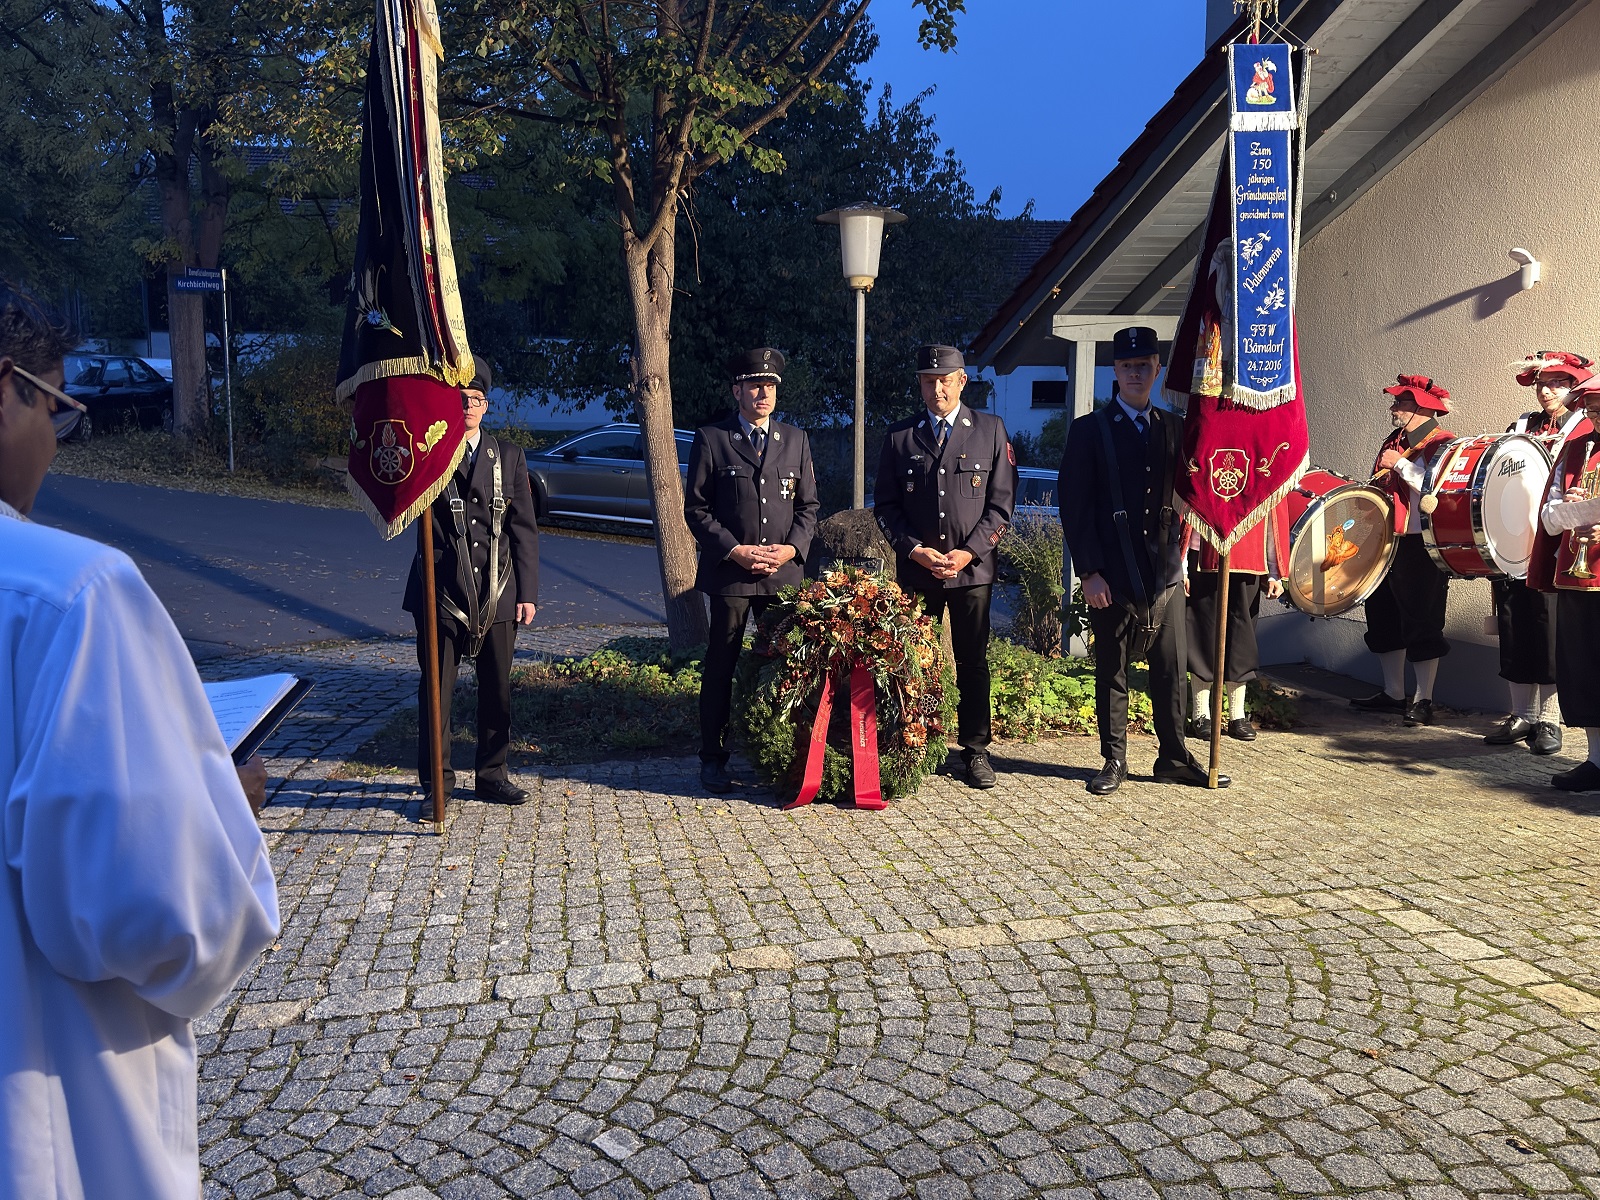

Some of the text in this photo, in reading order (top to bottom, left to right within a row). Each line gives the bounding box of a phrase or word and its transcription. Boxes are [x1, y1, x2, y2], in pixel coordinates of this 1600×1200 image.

[1250, 141, 1272, 156] Zum
[1252, 158, 1272, 170] 150
[1247, 173, 1275, 186] jährigen
[1236, 184, 1287, 205] Gründungsfest
[1239, 208, 1285, 222] gewidmet vom
[1242, 247, 1283, 294] Patenverein
[1243, 338, 1285, 357] Bärndorf
[1247, 359, 1282, 371] 24.7.2016
